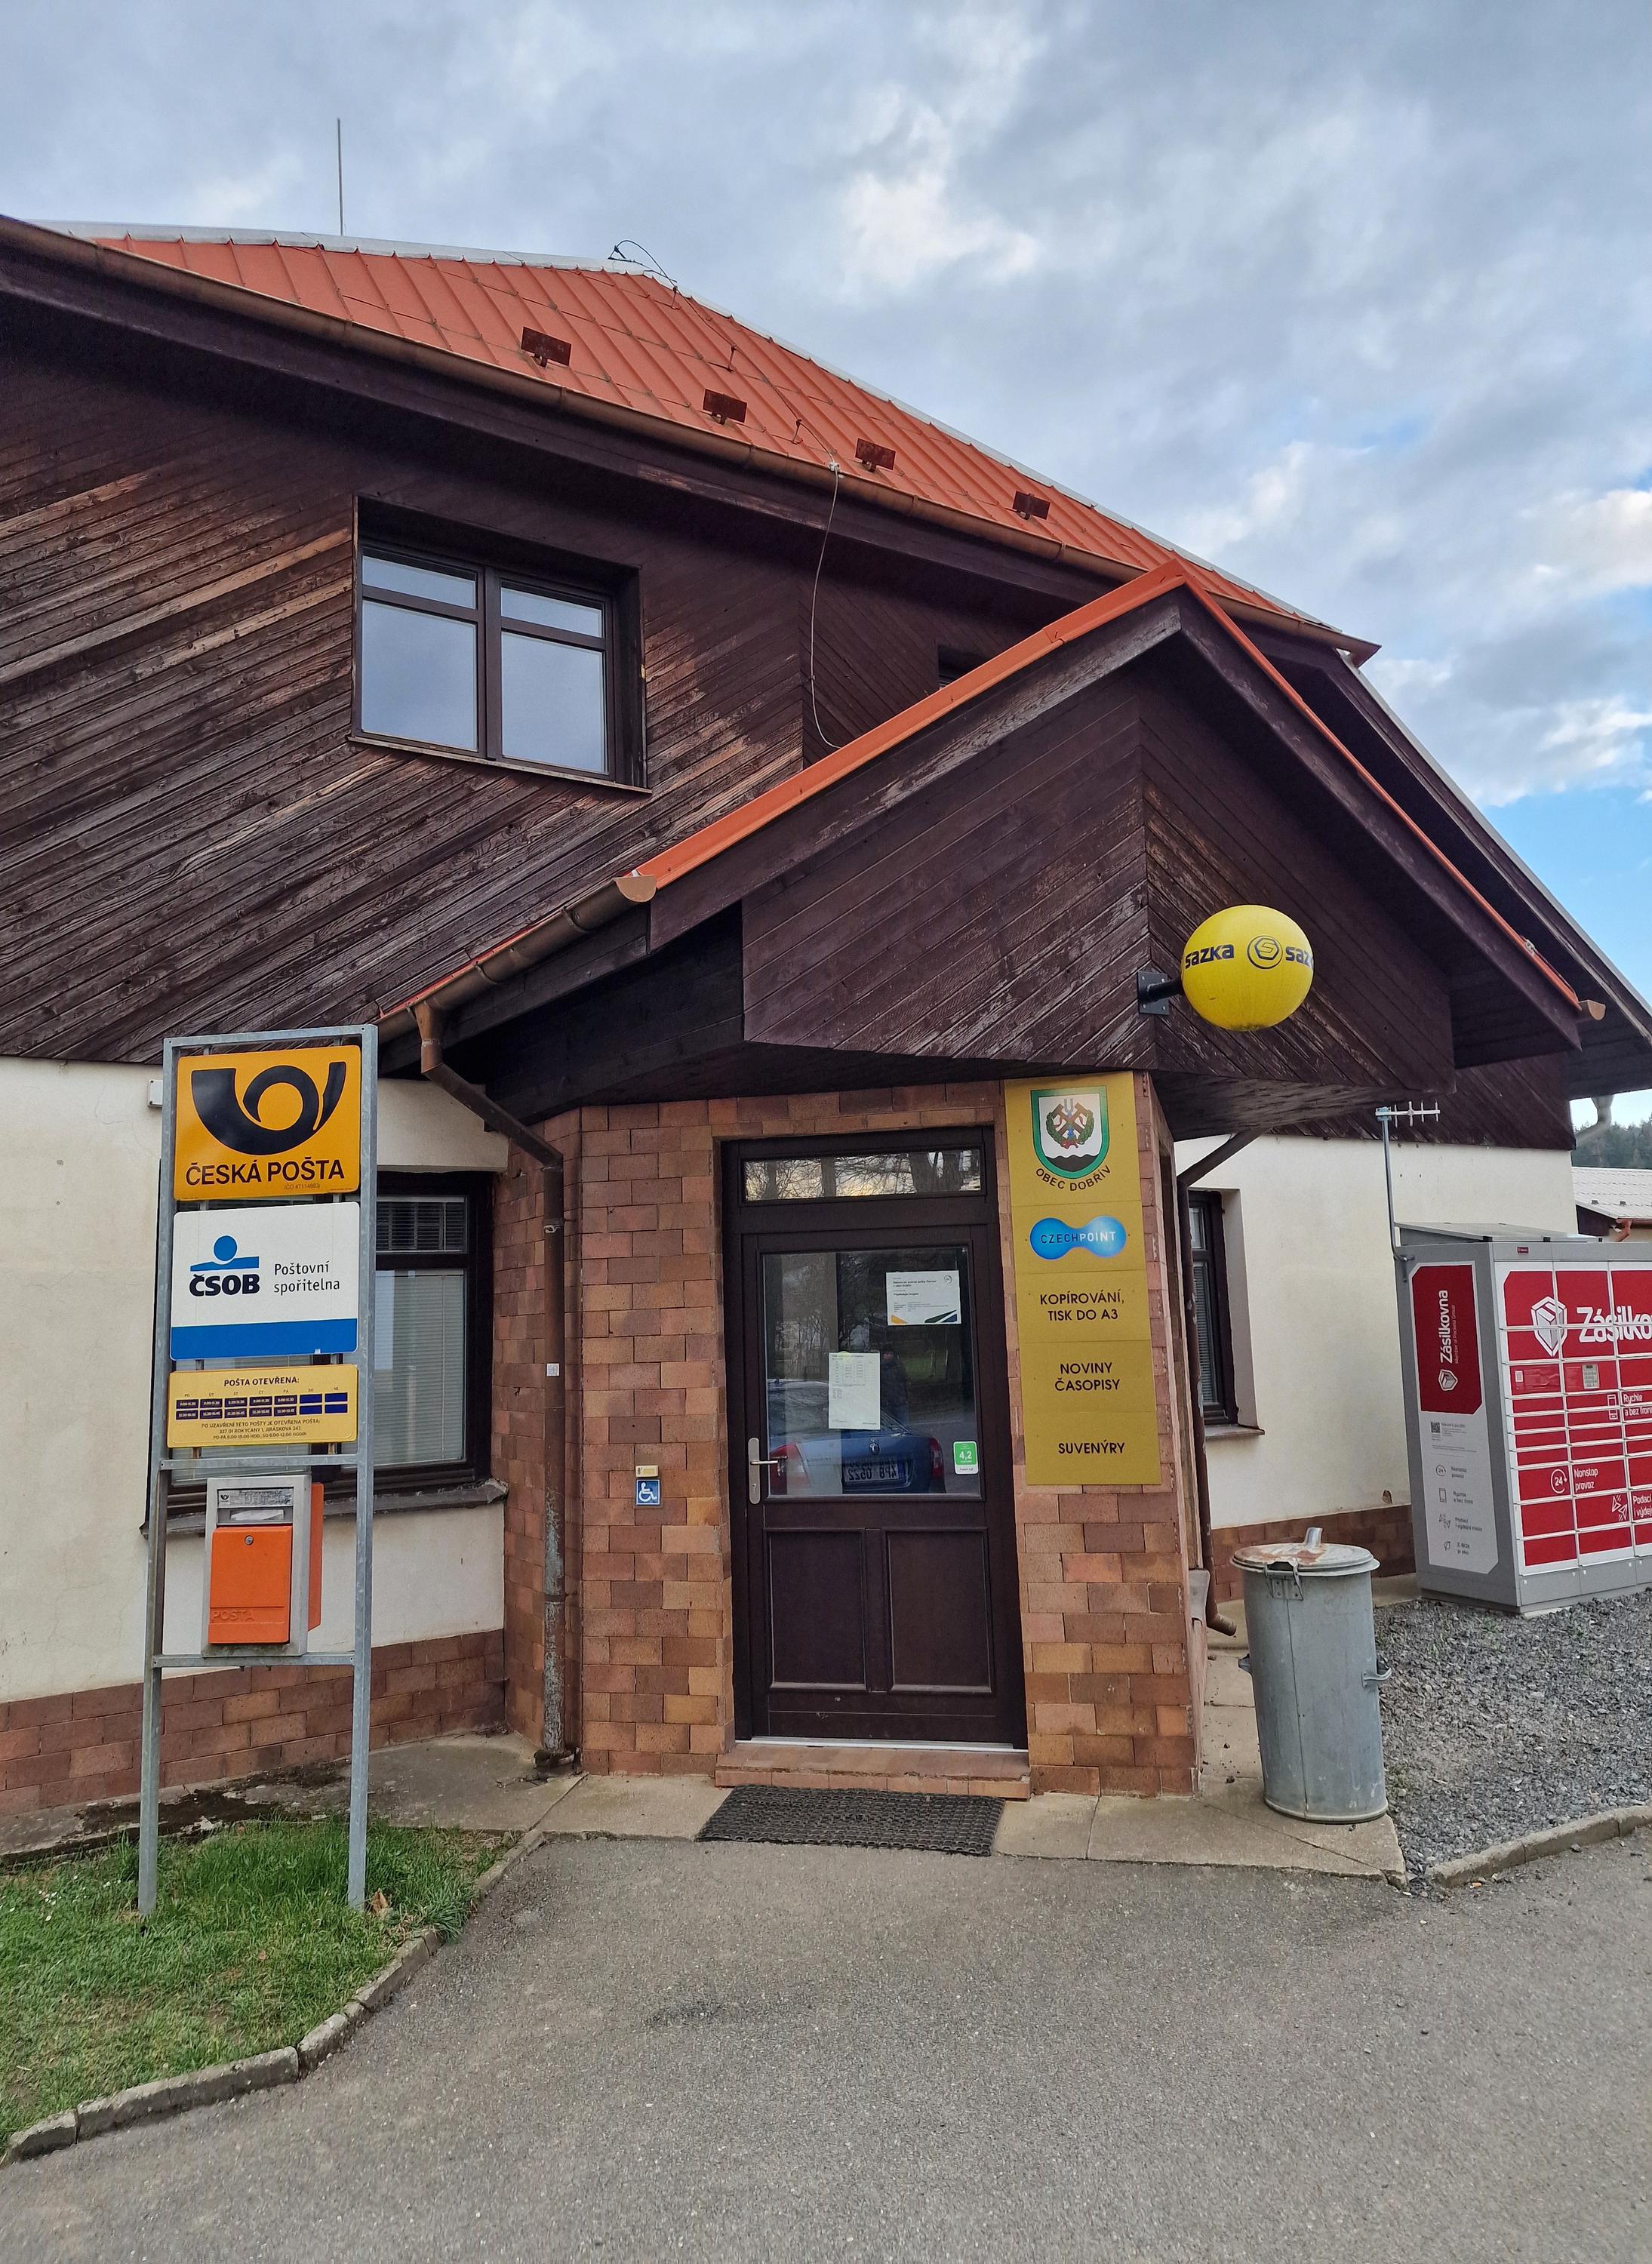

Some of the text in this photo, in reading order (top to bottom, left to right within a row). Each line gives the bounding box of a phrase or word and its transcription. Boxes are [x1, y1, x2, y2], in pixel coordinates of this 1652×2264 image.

[1184, 943, 1235, 970] sazka
[1285, 945, 1313, 970] saz
[186, 1156, 345, 1186] ČESKÁ POŠTA
[1035, 1164, 1111, 1192] OBEC DOBŘÍV
[274, 1260, 330, 1275] Poštovní
[189, 1273, 260, 1297] ČSOB
[274, 1278, 340, 1296] spořitelna
[1039, 1288, 1125, 1305] KOPÍROVÁNÍ,
[1047, 1309, 1118, 1321] TISK DO A3
[1438, 1289, 1453, 1364] Zásilkovna
[1576, 1305, 1652, 1343] Zásilko
[1060, 1361, 1113, 1374] NOVINY
[223, 1376, 300, 1387] POŠTA OTEVŘENA:
[1054, 1377, 1121, 1392] ČASOPISY
[1623, 1392, 1643, 1404] Rychle
[1629, 1407, 1640, 1416] bez
[1057, 1439, 1125, 1454] SUVENÝRY
[959, 1450, 973, 1460] 4,2
[1554, 1467, 1599, 1487] 24 Nonstop
[1575, 1481, 1595, 1492] provoz
[1636, 1504, 1652, 1518] výdej
